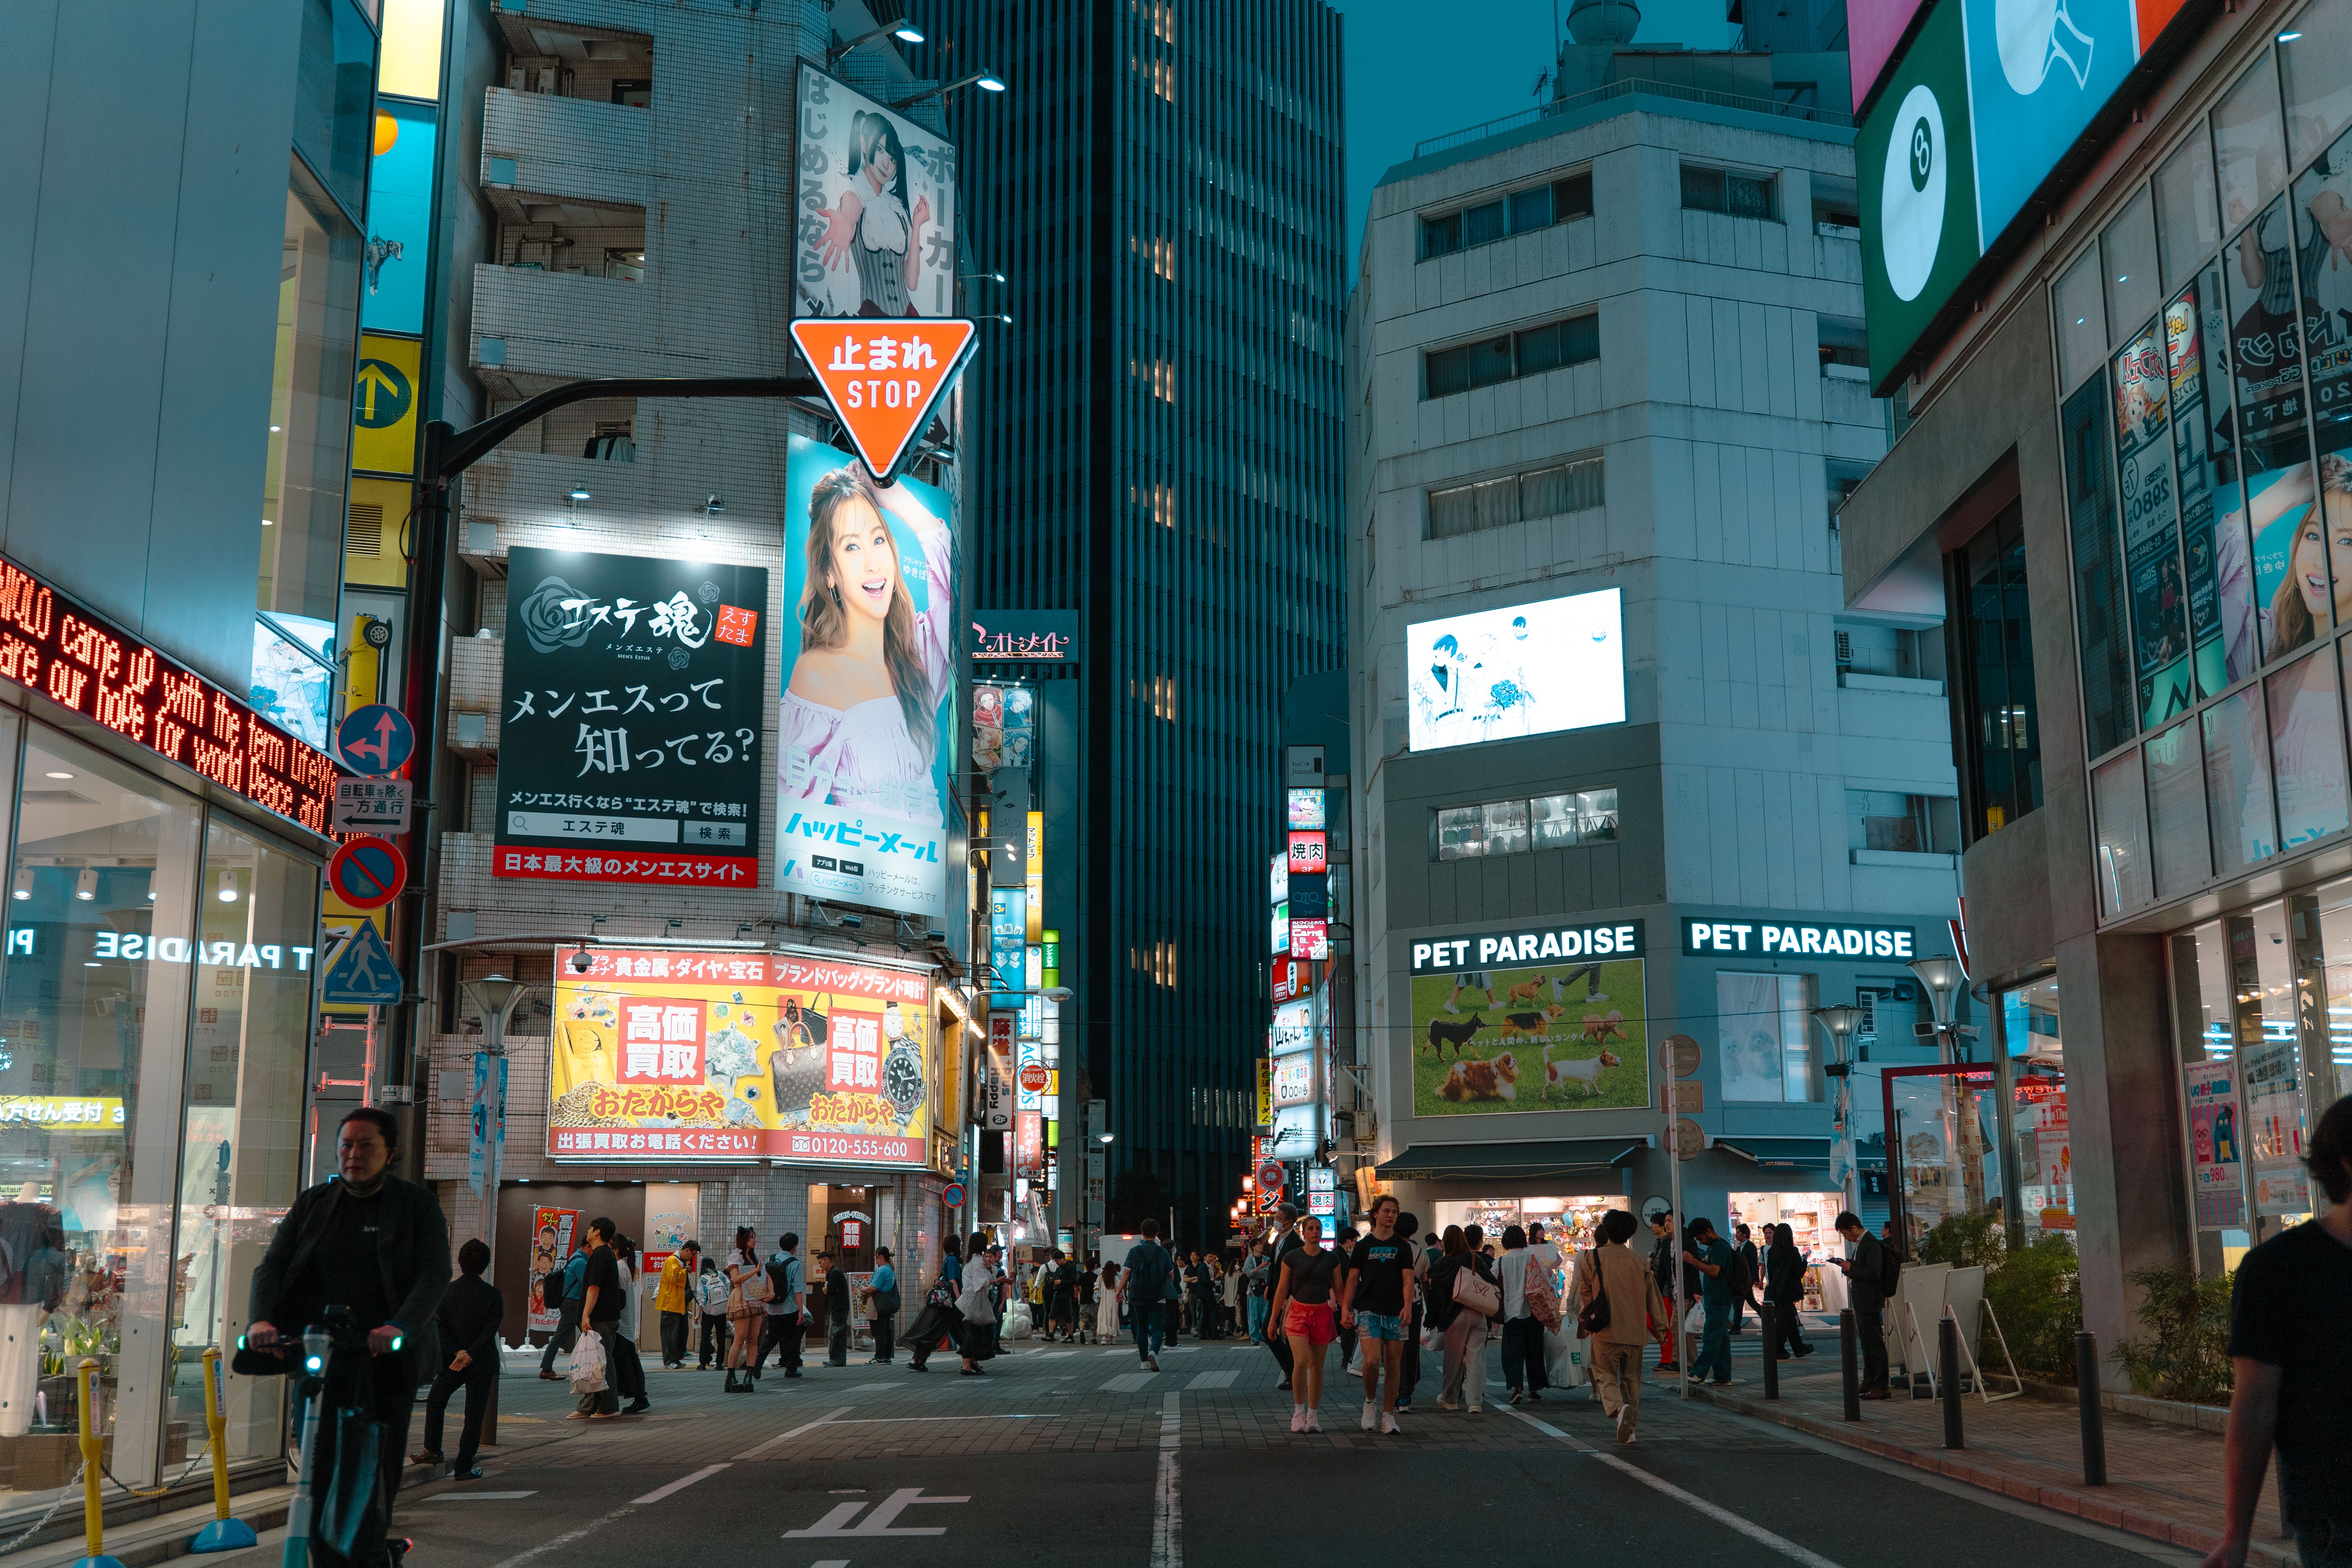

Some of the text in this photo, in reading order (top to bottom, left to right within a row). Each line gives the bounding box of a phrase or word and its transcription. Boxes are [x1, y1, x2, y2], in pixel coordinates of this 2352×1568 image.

[799, 71, 830, 283] はじめるなら
[926, 145, 955, 314] ポーカー
[828, 335, 937, 370] 止まれ
[848, 380, 921, 408] STOP
[903, 564, 934, 584] ゆきぽよ
[559, 590, 713, 649] エステ魂
[605, 643, 664, 655] メンズエステ
[61, 613, 120, 679] came
[129, 647, 155, 695] up
[163, 672, 205, 728] with
[213, 692, 240, 743] the
[248, 713, 285, 773] term
[507, 678, 724, 724] メンエスって
[0, 632, 325, 834] are our hope for world peace and
[574, 722, 755, 778] 知ってる?
[341, 783, 404, 798] 自転車を除く
[786, 745, 939, 817] 自分らしく出会う
[340, 799, 404, 814] 一方通行
[562, 820, 731, 840] エステ魂 検索
[784, 812, 938, 863] ハッピーメール
[816, 859, 833, 868] アプリ版
[1291, 842, 1323, 860] 焼肉
[505, 852, 745, 881] 日本最大級のメンエスサイト
[845, 864, 859, 873] Web版
[822, 877, 859, 890] ハッピーメール
[867, 883, 938, 903] マッチングサービスです
[995, 904, 1005, 913] 3F
[1414, 925, 1635, 969] PET PARADISE
[1691, 923, 1913, 957] PET PARADISE
[774, 962, 925, 1000] ブランドバッグ・ブランド時計
[626, 1005, 698, 1042] 高価
[832, 1016, 878, 1053] 高価
[992, 1018, 1011, 1056] 麻雀
[1469, 1032, 1586, 1047] ペットと人間の、新しいカンケイ
[624, 1043, 698, 1079] 買取
[831, 1051, 878, 1089] 買取
[2261, 1048, 2284, 1065] IKEBUKURO
[989, 1067, 1000, 1109] Happy
[1002, 1067, 1011, 1096] Plus
[1022, 1073, 1045, 1084] 消火栓
[594, 1089, 725, 1118] おたからや
[811, 1095, 895, 1126] おたからや
[558, 1132, 758, 1150] 出張買取お電話ください!
[811, 1136, 908, 1158] 0120-555-600
[2210, 1167, 2225, 1182] 980
[1311, 1195, 1333, 1206] 焼肉
[554, 1214, 575, 1272] 高価買取
[843, 1222, 859, 1235] 高価
[843, 1235, 859, 1247] 買取
[781, 1488, 971, 1538] 止
